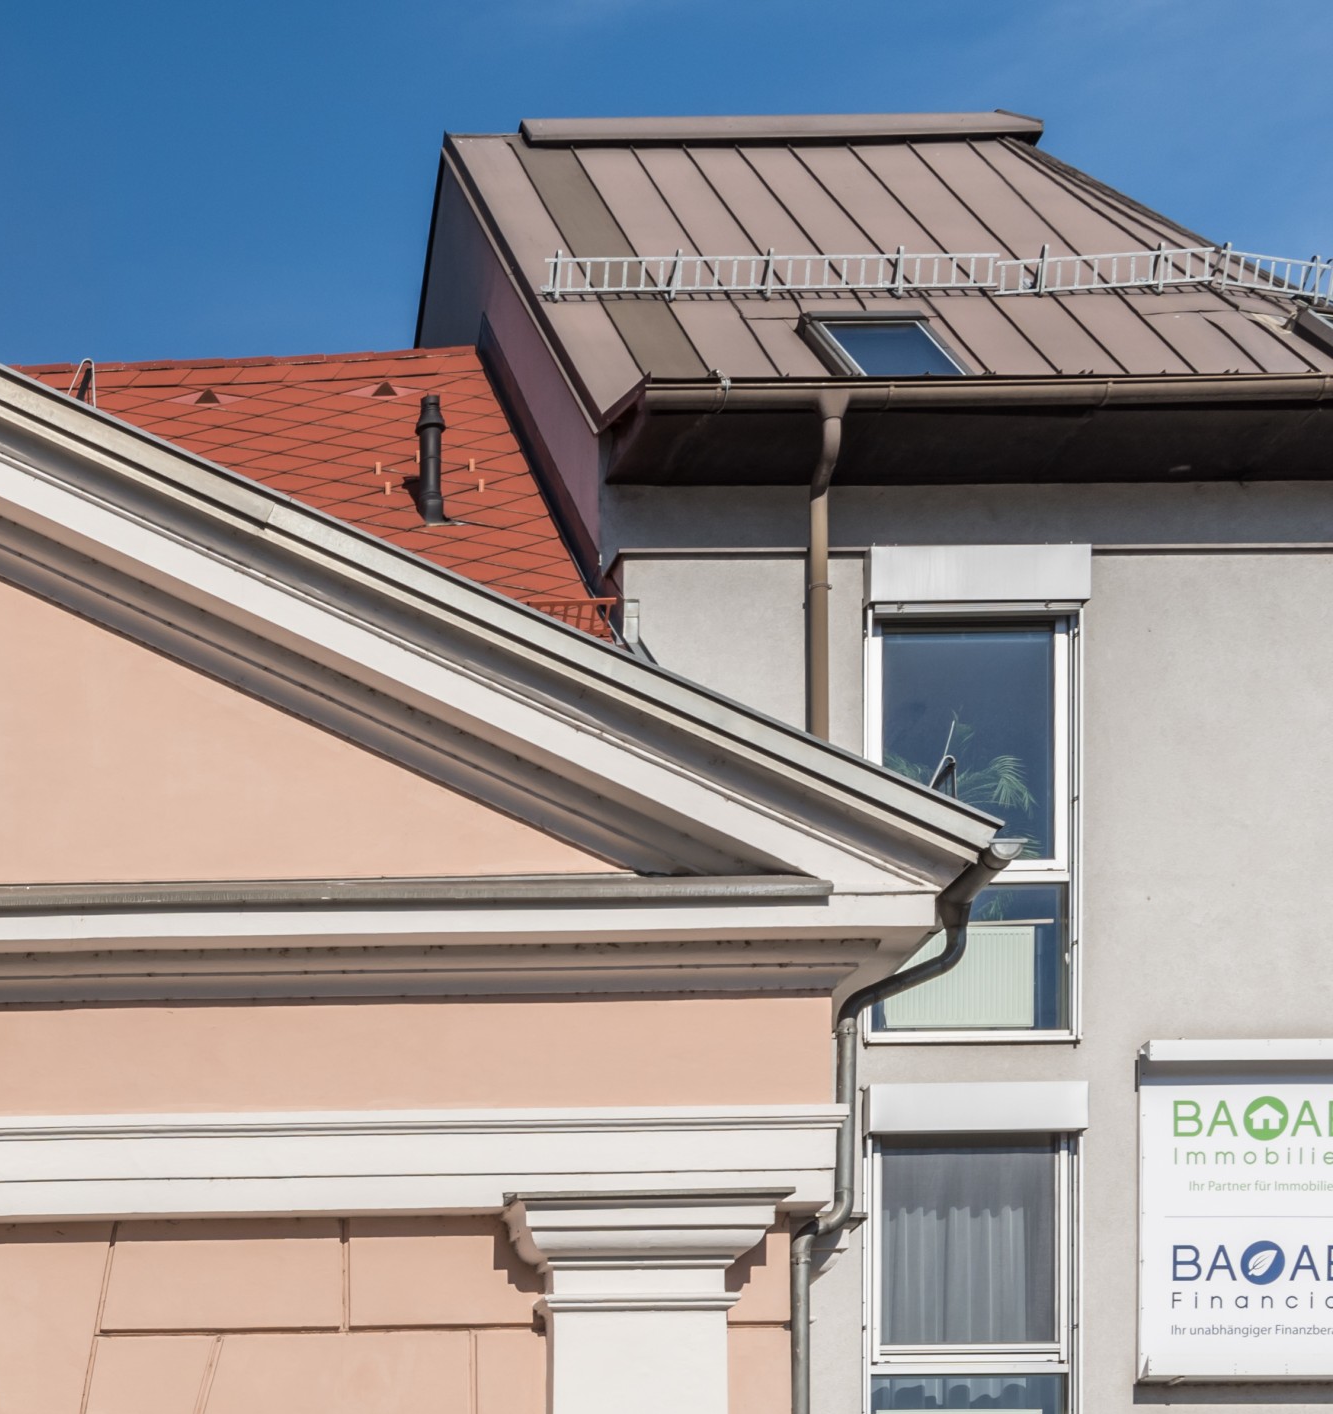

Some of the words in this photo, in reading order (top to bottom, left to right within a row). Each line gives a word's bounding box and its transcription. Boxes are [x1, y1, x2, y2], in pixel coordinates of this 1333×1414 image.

[1173, 1096, 1333, 1141] BAOA
[1188, 1180, 1205, 1191] Ihr
[1208, 1180, 1251, 1192] Partner
[1254, 1180, 1271, 1191] für
[1172, 1240, 1333, 1285] BAOA
[1171, 1325, 1186, 1335] Ihr
[1190, 1325, 1271, 1337] unabhängiger
